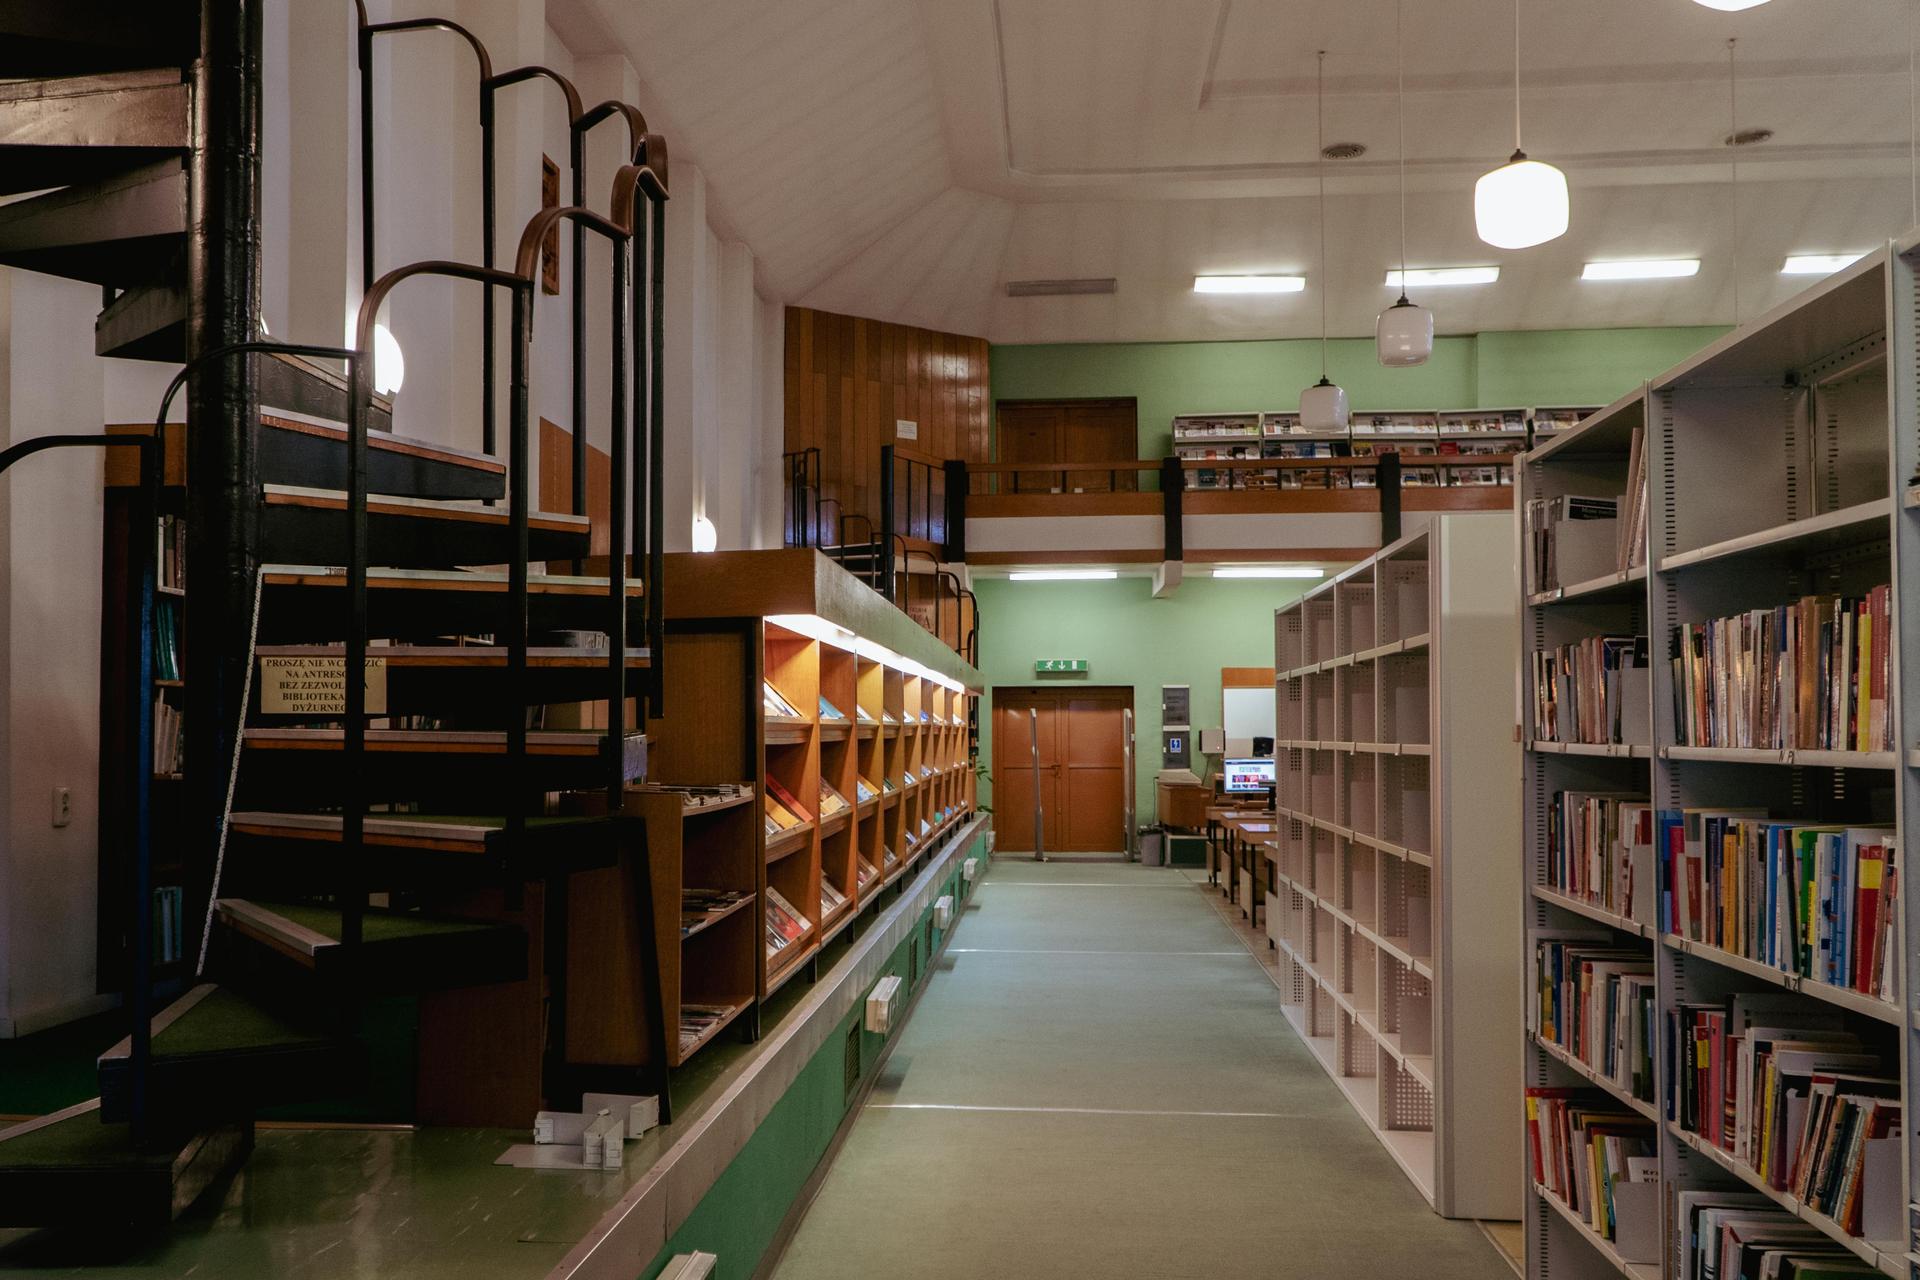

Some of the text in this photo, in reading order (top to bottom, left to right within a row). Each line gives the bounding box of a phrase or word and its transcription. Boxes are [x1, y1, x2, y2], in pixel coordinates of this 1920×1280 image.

[266, 659, 305, 668] PROSZĘ
[308, 659, 324, 667] NIE
[286, 670, 345, 678] NA ANTRES
[279, 681, 298, 689] BEZ
[283, 692, 345, 700] BIBLIOTEKA
[292, 702, 345, 712] DYŻURNE
